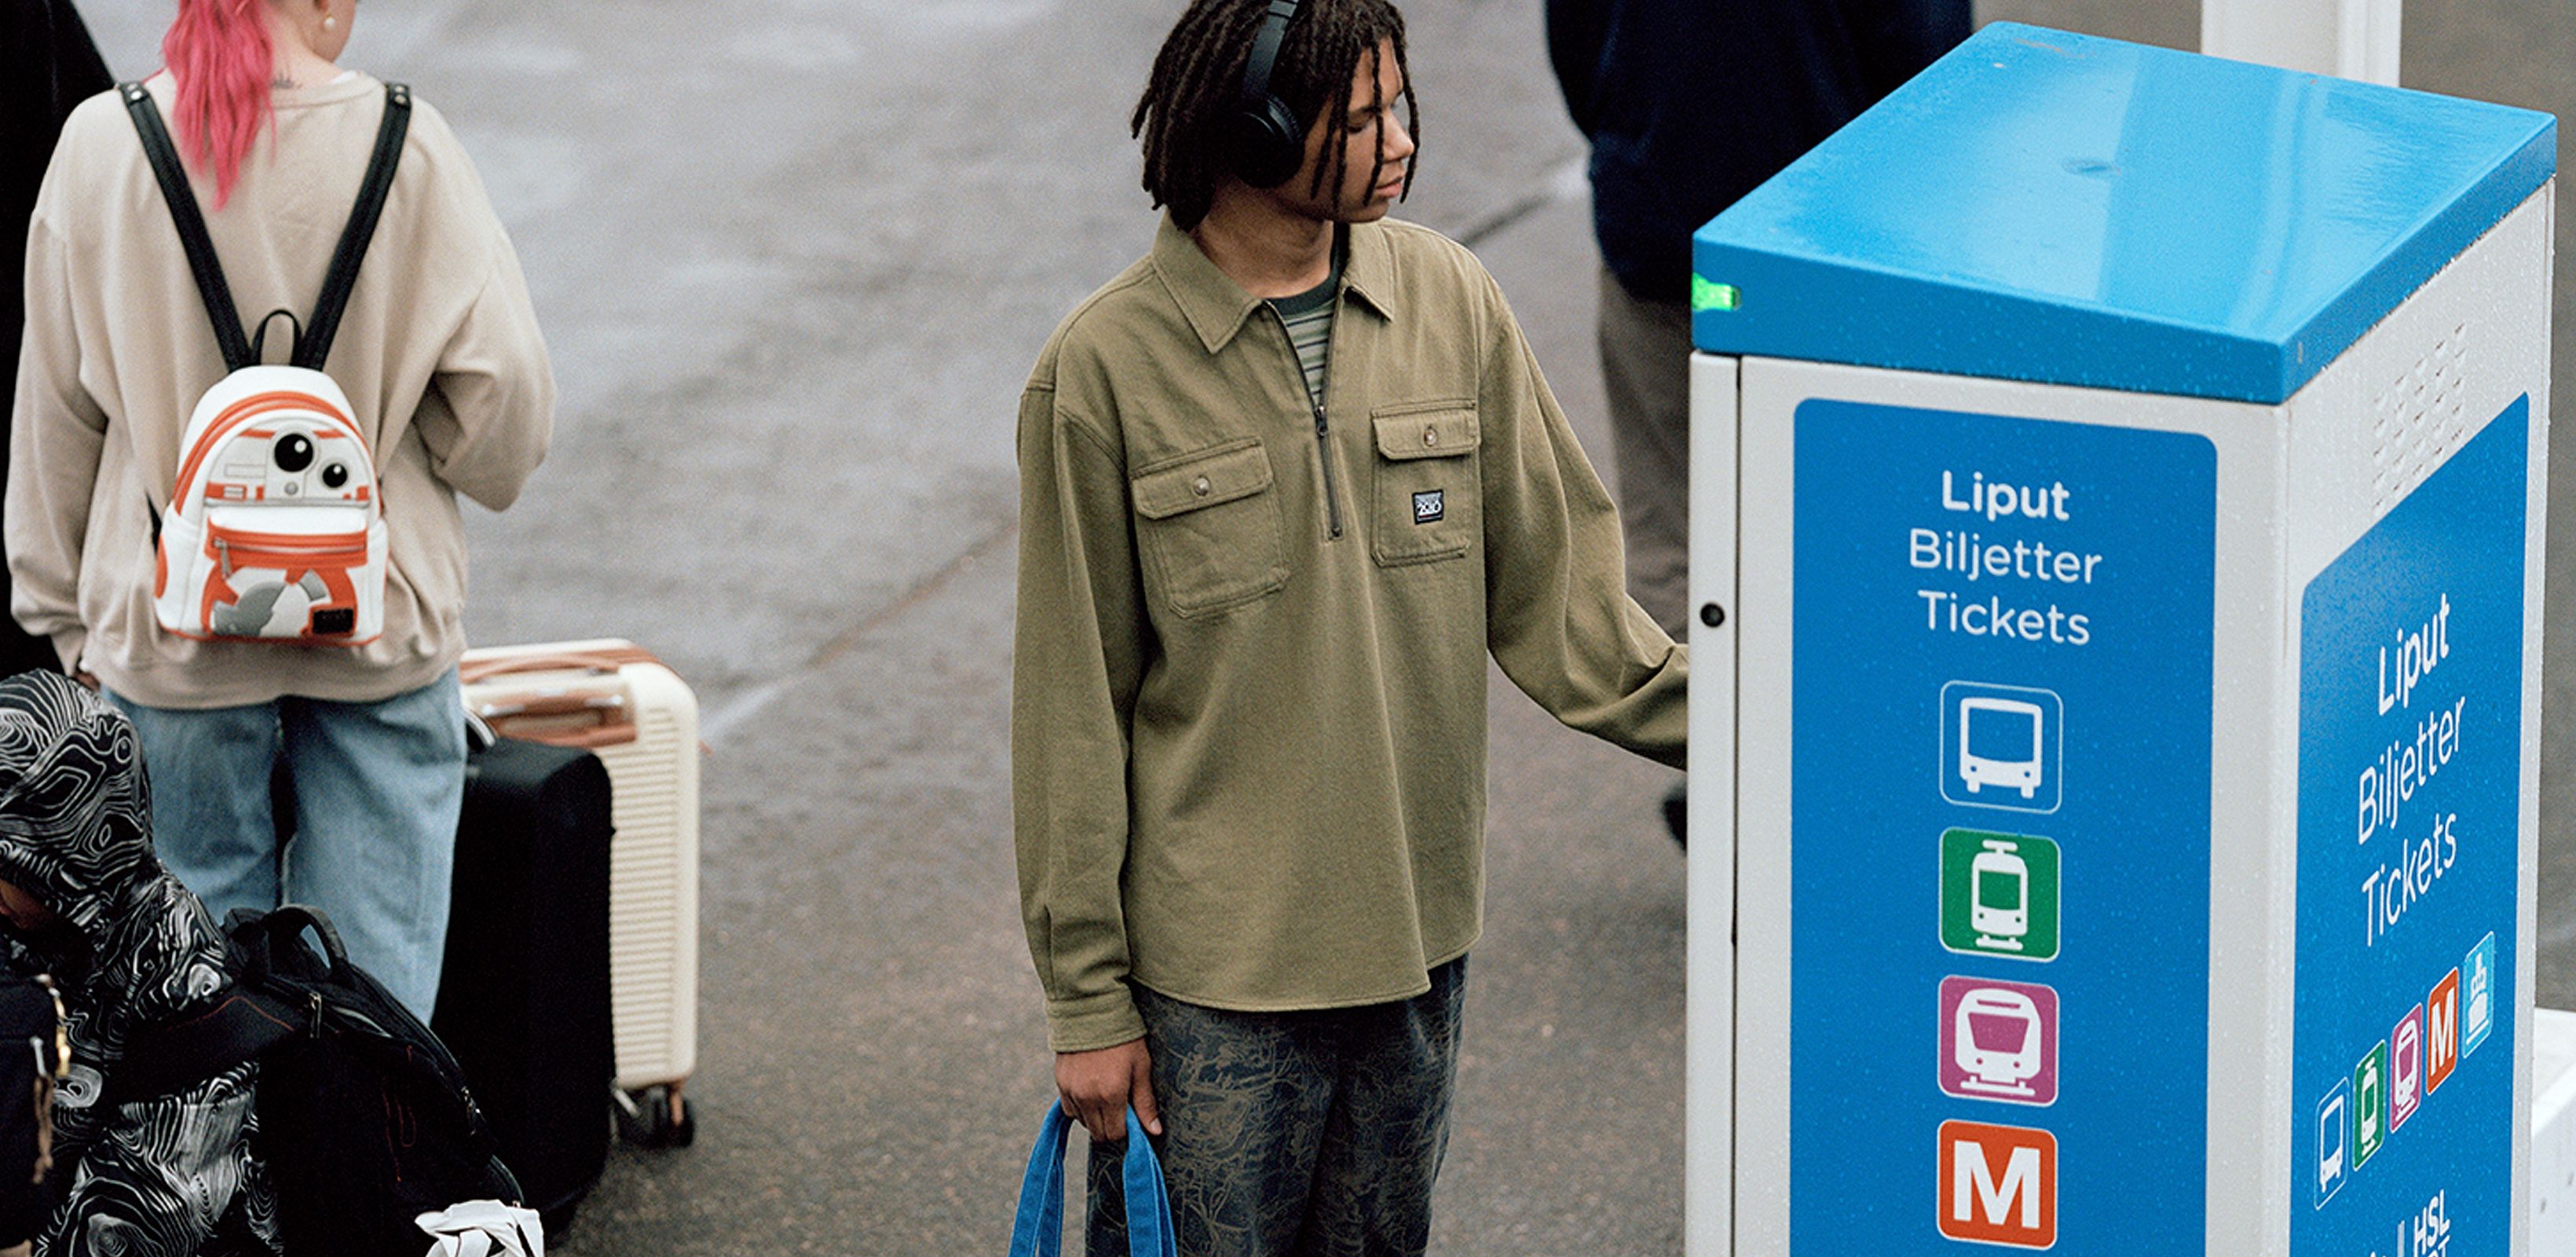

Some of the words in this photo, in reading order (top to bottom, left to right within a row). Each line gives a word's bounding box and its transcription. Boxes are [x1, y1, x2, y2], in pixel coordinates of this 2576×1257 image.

[1942, 470, 2070, 522] Liput
[1909, 528, 2102, 584] Biljetter
[1918, 589, 2090, 645] Tickets
[2378, 592, 2450, 716] Liput
[2358, 696, 2466, 845] Biljetter
[2361, 812, 2457, 947] Tickets
[2430, 987, 2455, 1076] M
[1952, 1139, 2041, 1230] M
[2413, 1189, 2450, 1257] HSL
